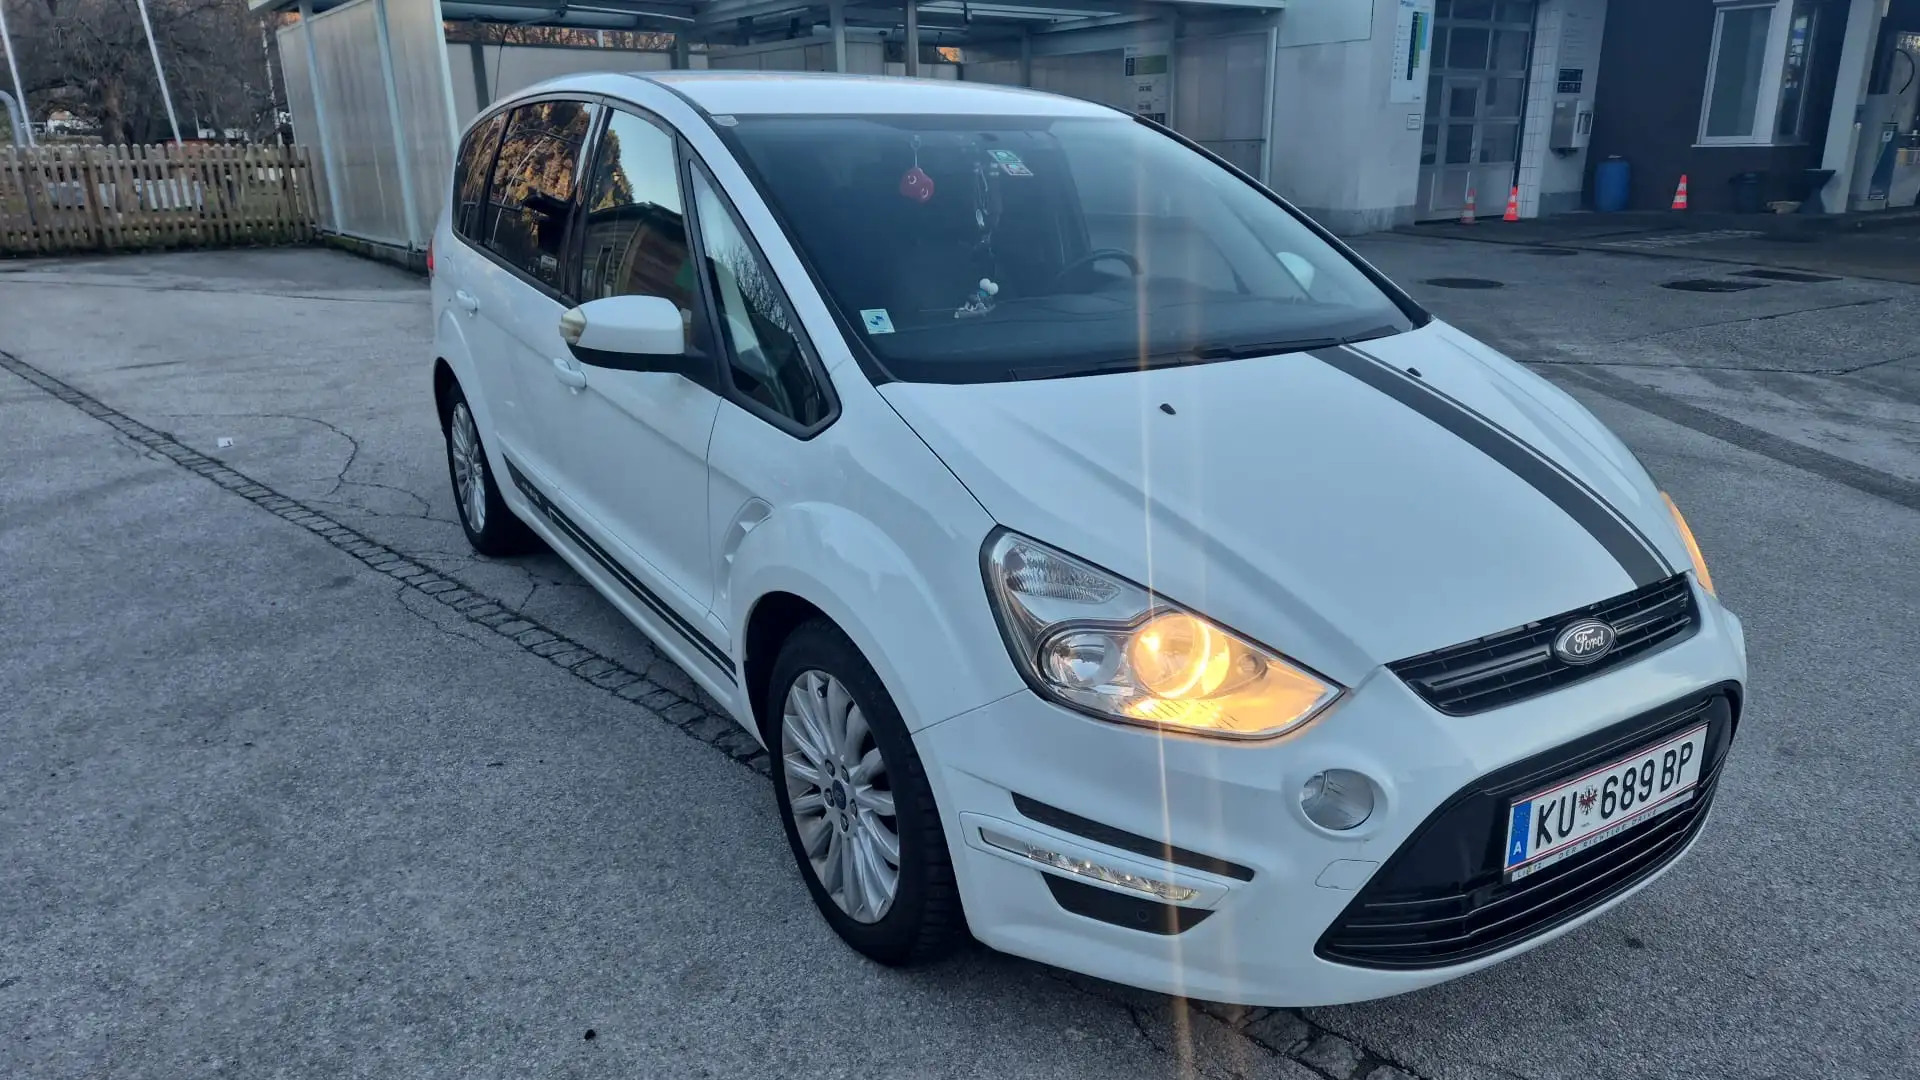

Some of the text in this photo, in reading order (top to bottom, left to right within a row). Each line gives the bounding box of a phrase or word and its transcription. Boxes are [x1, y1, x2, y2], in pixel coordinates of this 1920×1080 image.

[1574, 628, 1605, 654] Ford
[1535, 742, 1693, 849] KU 689 BP
[1514, 842, 1522, 855] A
[1559, 847, 1576, 859] DER
[1583, 824, 1627, 848] RICHTIGE
